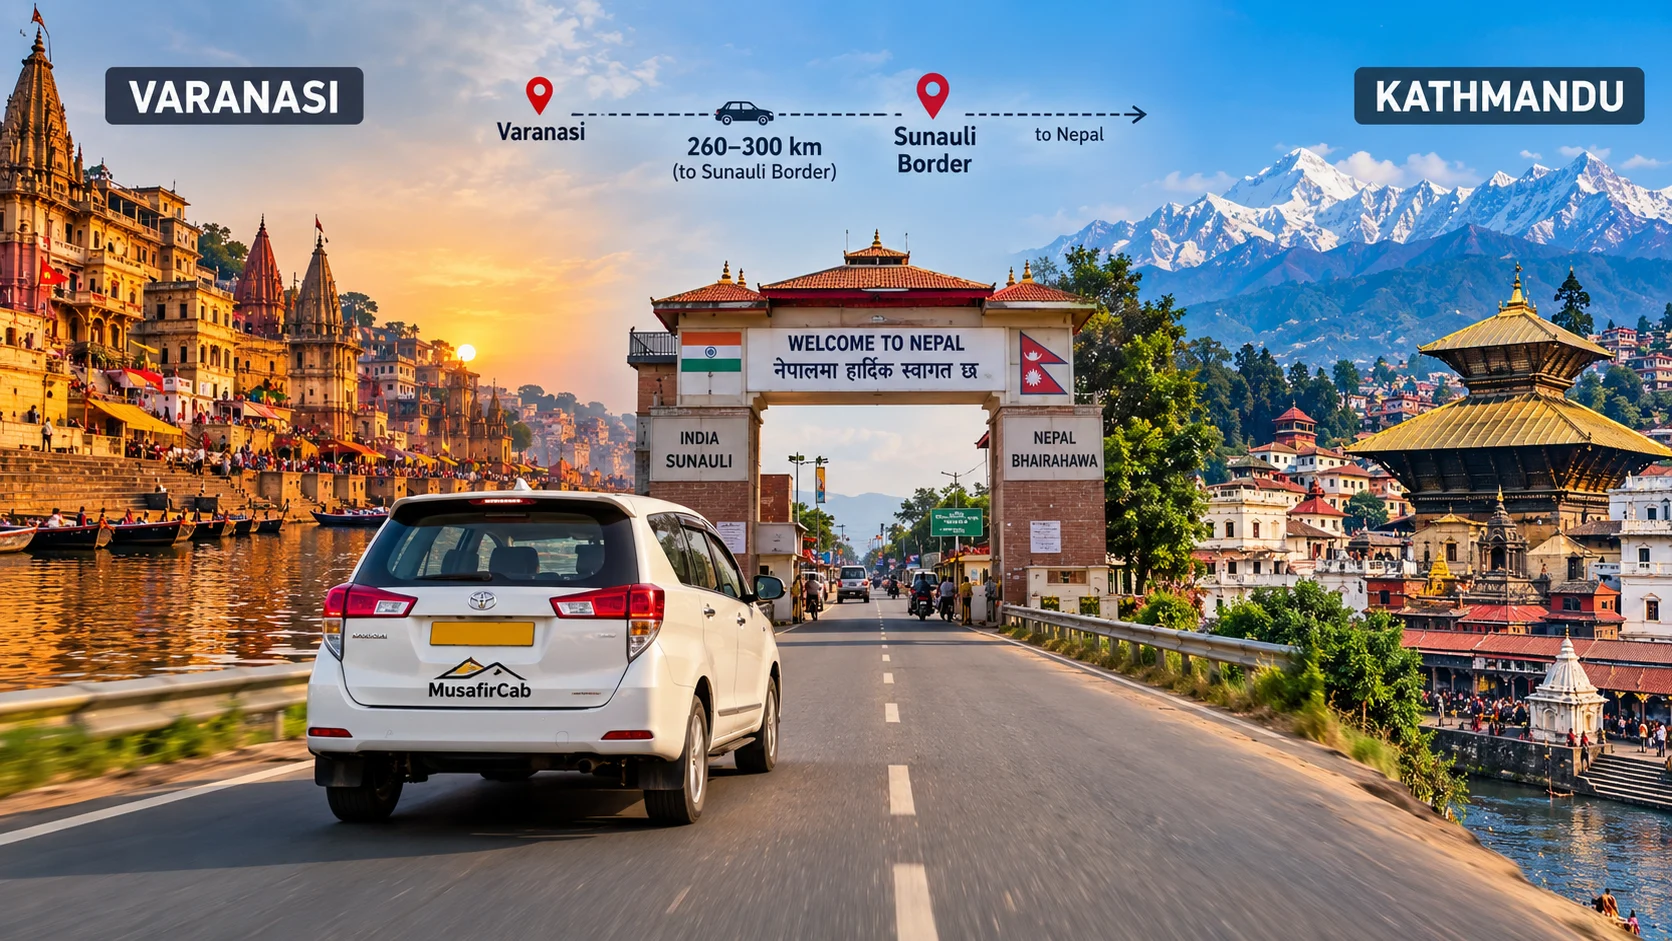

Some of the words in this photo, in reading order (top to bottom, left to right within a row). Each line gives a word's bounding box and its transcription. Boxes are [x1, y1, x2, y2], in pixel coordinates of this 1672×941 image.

[788, 334, 875, 352] WELCOME
[881, 334, 904, 352] TO
[910, 334, 965, 352] NEPAL
[773, 357, 839, 380] नेपालमा
[845, 357, 894, 382] हार्दिक
[901, 362, 954, 380] स्वागत
[959, 362, 980, 380] छ
[680, 430, 720, 446] INDIA
[1033, 430, 1077, 445] NEPAL
[665, 453, 733, 469] SUNAULI
[1011, 453, 1099, 468] BHAIRAHAWA
[428, 682, 532, 699] MusafirCab
